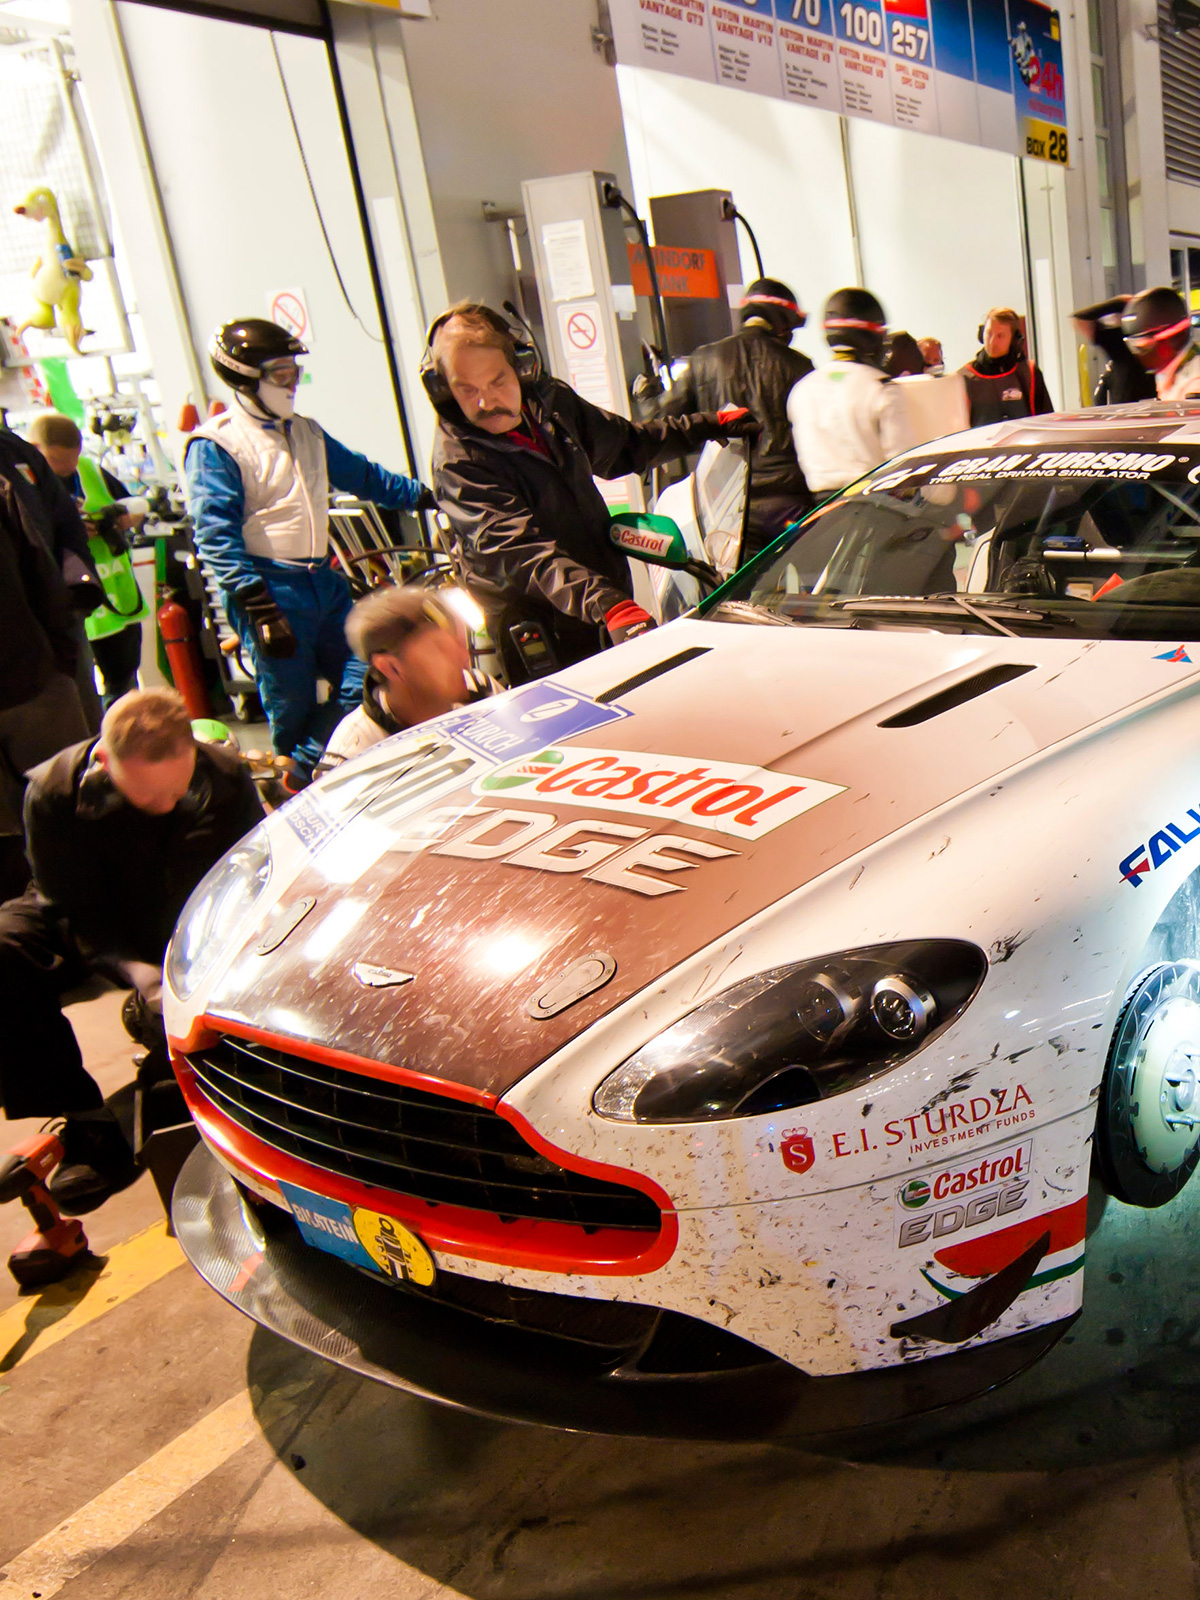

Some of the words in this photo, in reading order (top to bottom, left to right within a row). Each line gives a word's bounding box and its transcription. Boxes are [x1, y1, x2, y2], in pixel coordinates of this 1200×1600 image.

[639, 0, 683, 21] VANTAGE
[711, 6, 740, 24] ASTON
[743, 15, 774, 34] MARTIN
[716, 20, 754, 42] VANTAGE
[840, 2, 883, 47] 100
[891, 20, 929, 62] 257
[1026, 136, 1046, 158] BOX
[1049, 130, 1068, 163] 28
[655, 273, 691, 295] ANK
[929, 475, 957, 485] THE
[956, 473, 992, 482] REAL
[995, 469, 1057, 480] DRIVING
[1058, 469, 1151, 480] SIMULATOR
[938, 454, 1032, 477] GRAN
[1025, 452, 1176, 472] TURISMO
[621, 529, 665, 552] Castrol
[535, 756, 807, 827] Castrol
[398, 803, 743, 897] EDGE
[832, 1128, 878, 1158] E.I.
[884, 1084, 1034, 1147] STURDZA
[910, 1123, 992, 1154] INVESTMENT
[996, 1109, 1036, 1130] FUNDS
[933, 1146, 1024, 1201] Castrol
[291, 1203, 360, 1245] BILSTEIN
[898, 1179, 1031, 1249] EDGE
